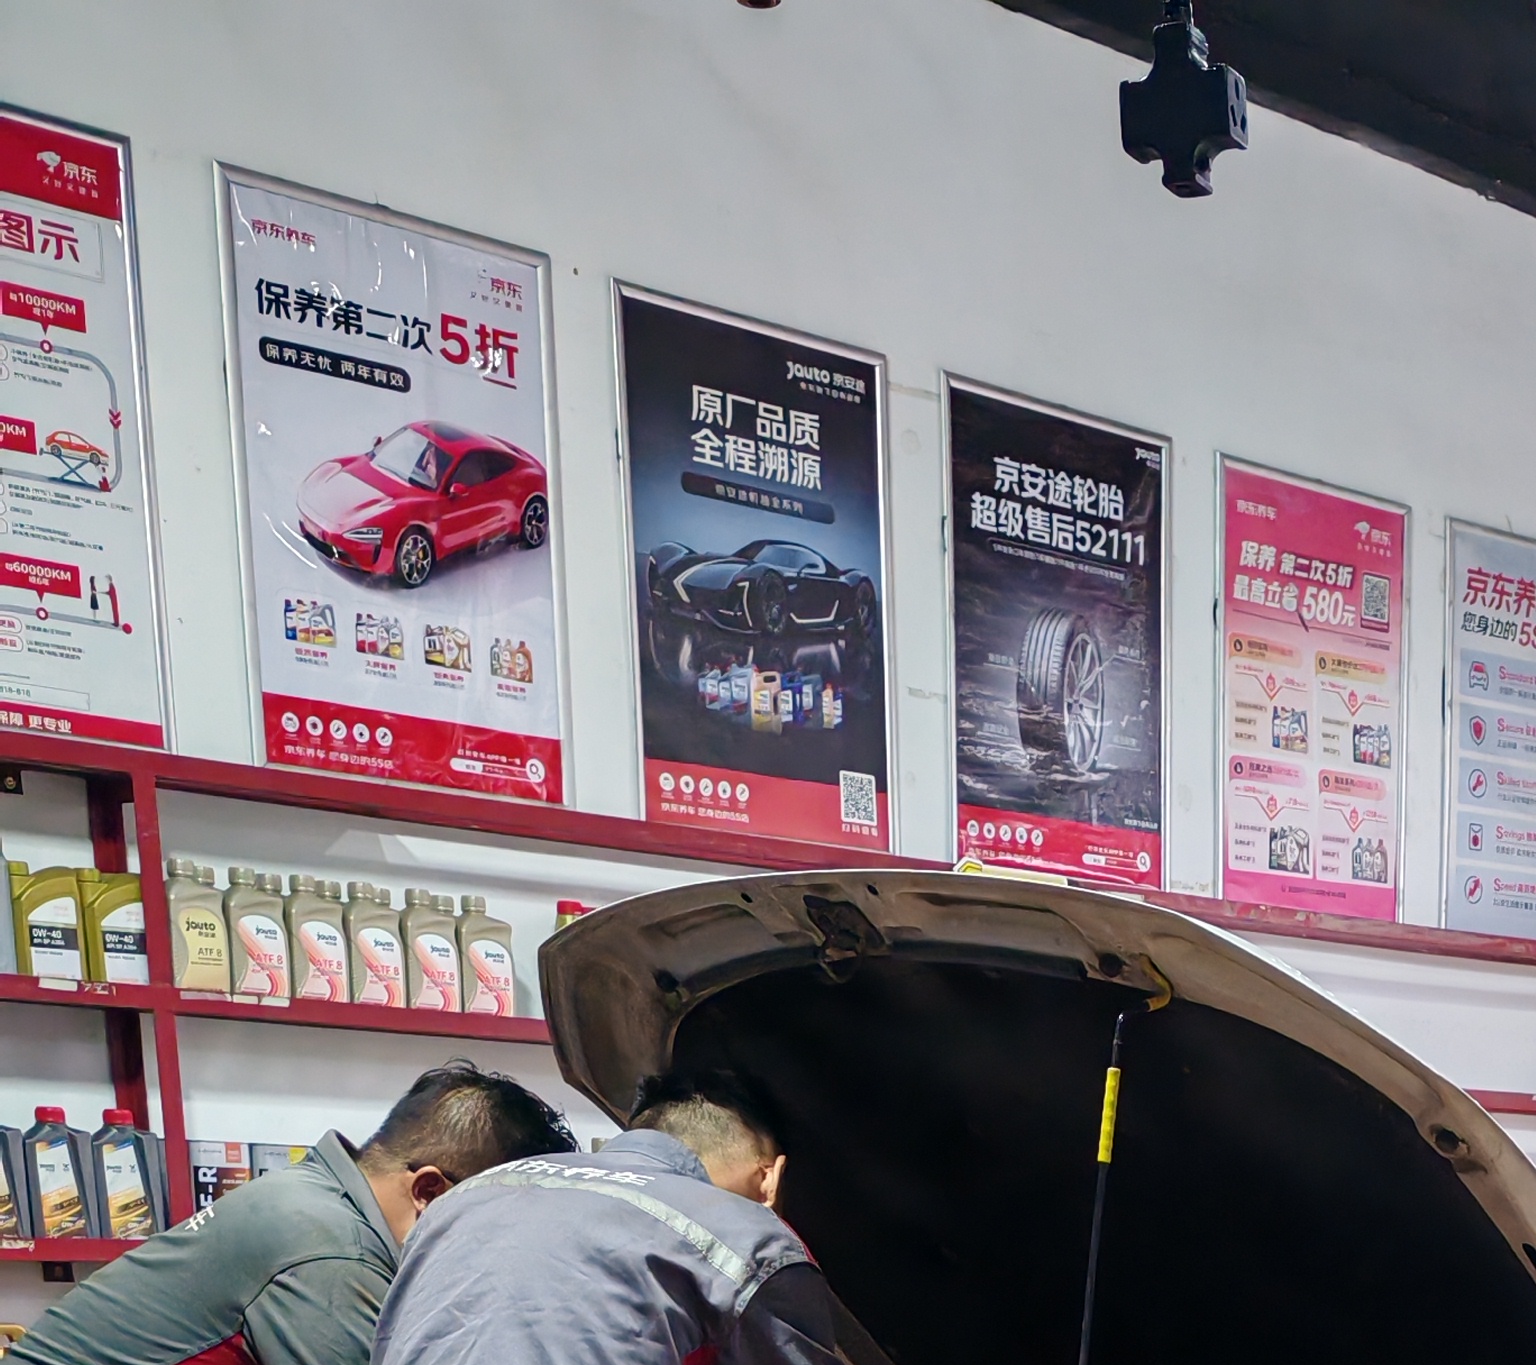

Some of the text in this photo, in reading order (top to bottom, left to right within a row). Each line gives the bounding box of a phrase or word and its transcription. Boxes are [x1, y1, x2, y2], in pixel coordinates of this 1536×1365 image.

[63, 160, 98, 185] 京东
[490, 277, 522, 300] 京东
[266, 342, 405, 388] 保养无忧 两年有效
[691, 384, 820, 450] 原厂品质
[691, 428, 822, 491] 全程溯源
[993, 456, 1124, 521] 京安途轮胎
[970, 492, 1145, 566] 超级售后52111
[1239, 540, 1355, 589] 保养 第二次5折
[1233, 574, 1357, 627] 最高立省580元
[29, 714, 72, 734] 更专业
[198, 947, 214, 957] ATF
